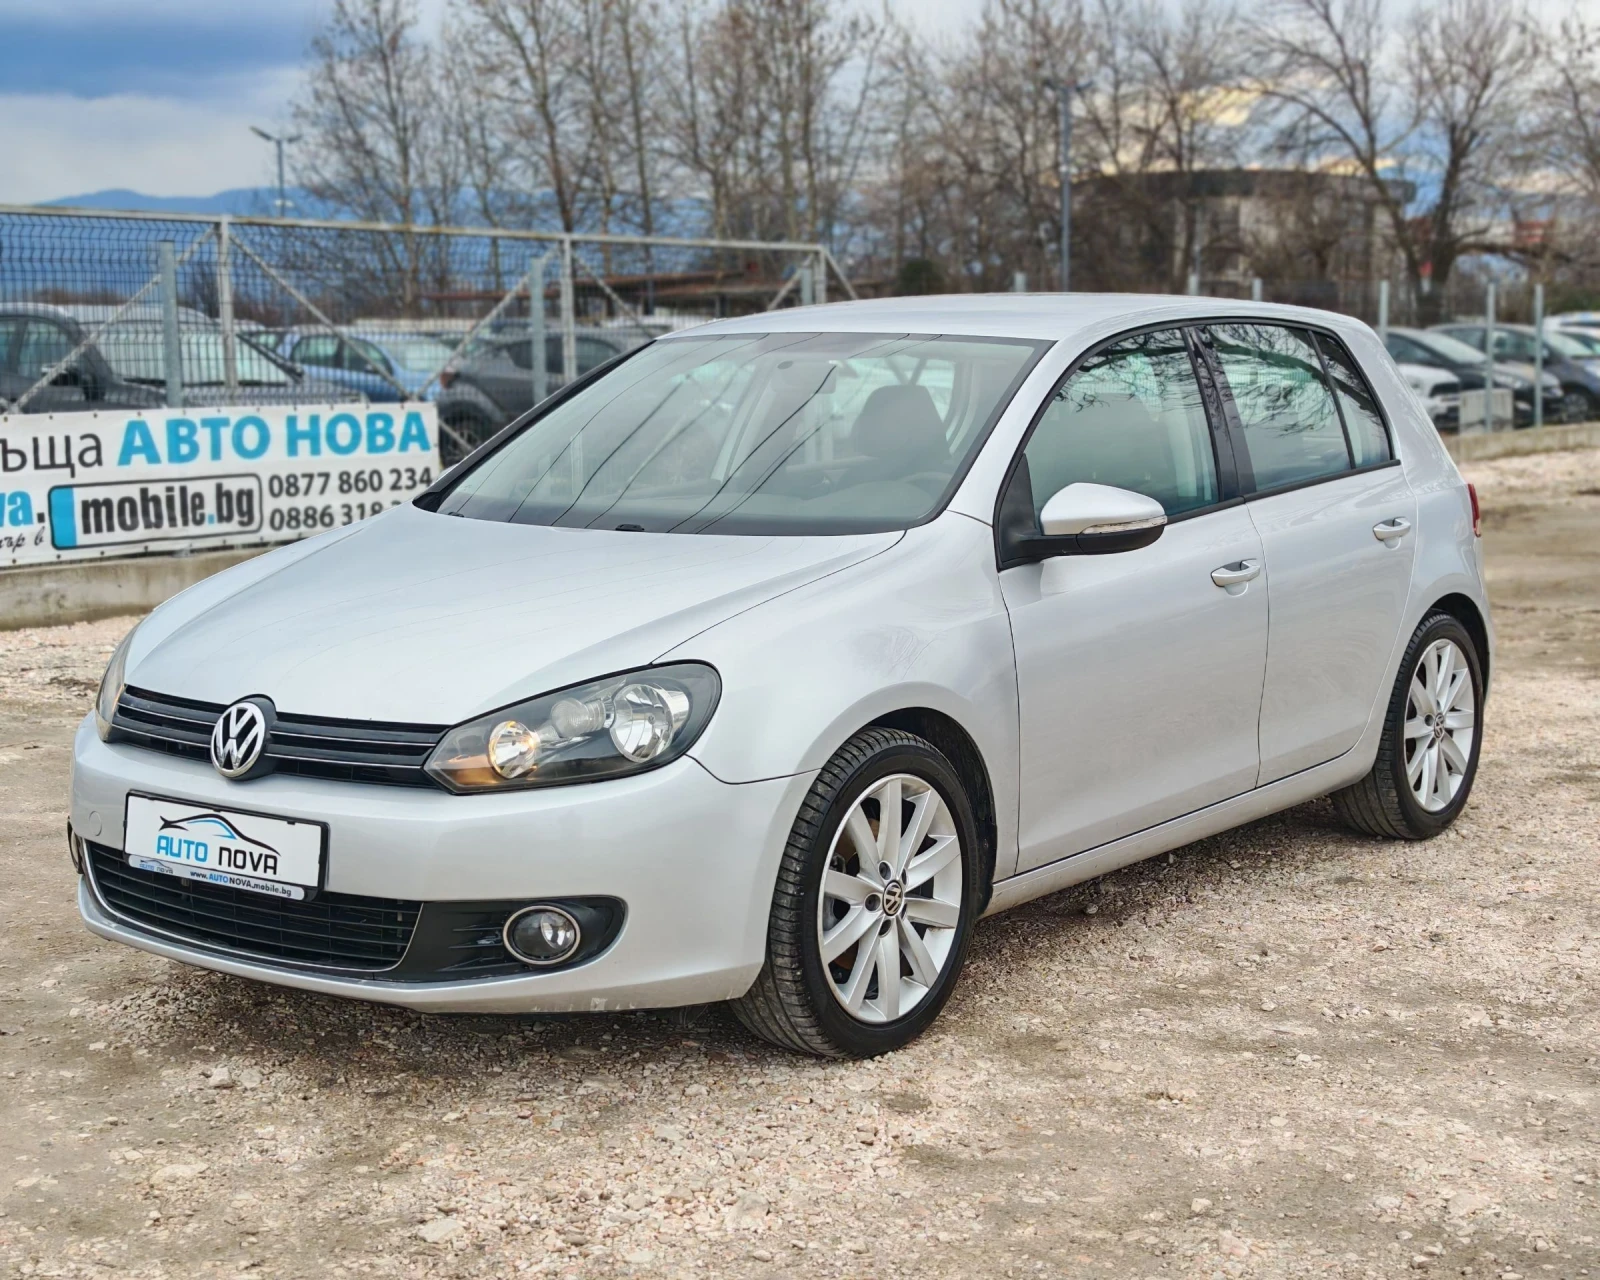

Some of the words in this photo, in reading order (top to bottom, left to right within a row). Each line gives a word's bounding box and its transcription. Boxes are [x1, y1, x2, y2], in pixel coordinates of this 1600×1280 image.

[118, 416, 270, 466] АВТО
[286, 412, 431, 457] НОВА
[268, 472, 331, 498] 0877
[338, 469, 383, 494] 860
[389, 467, 433, 491] 234
[82, 484, 255, 534] mobile.bg
[269, 505, 335, 531] 0886
[211, 702, 265, 778] VW
[156, 835, 208, 863] AUTO
